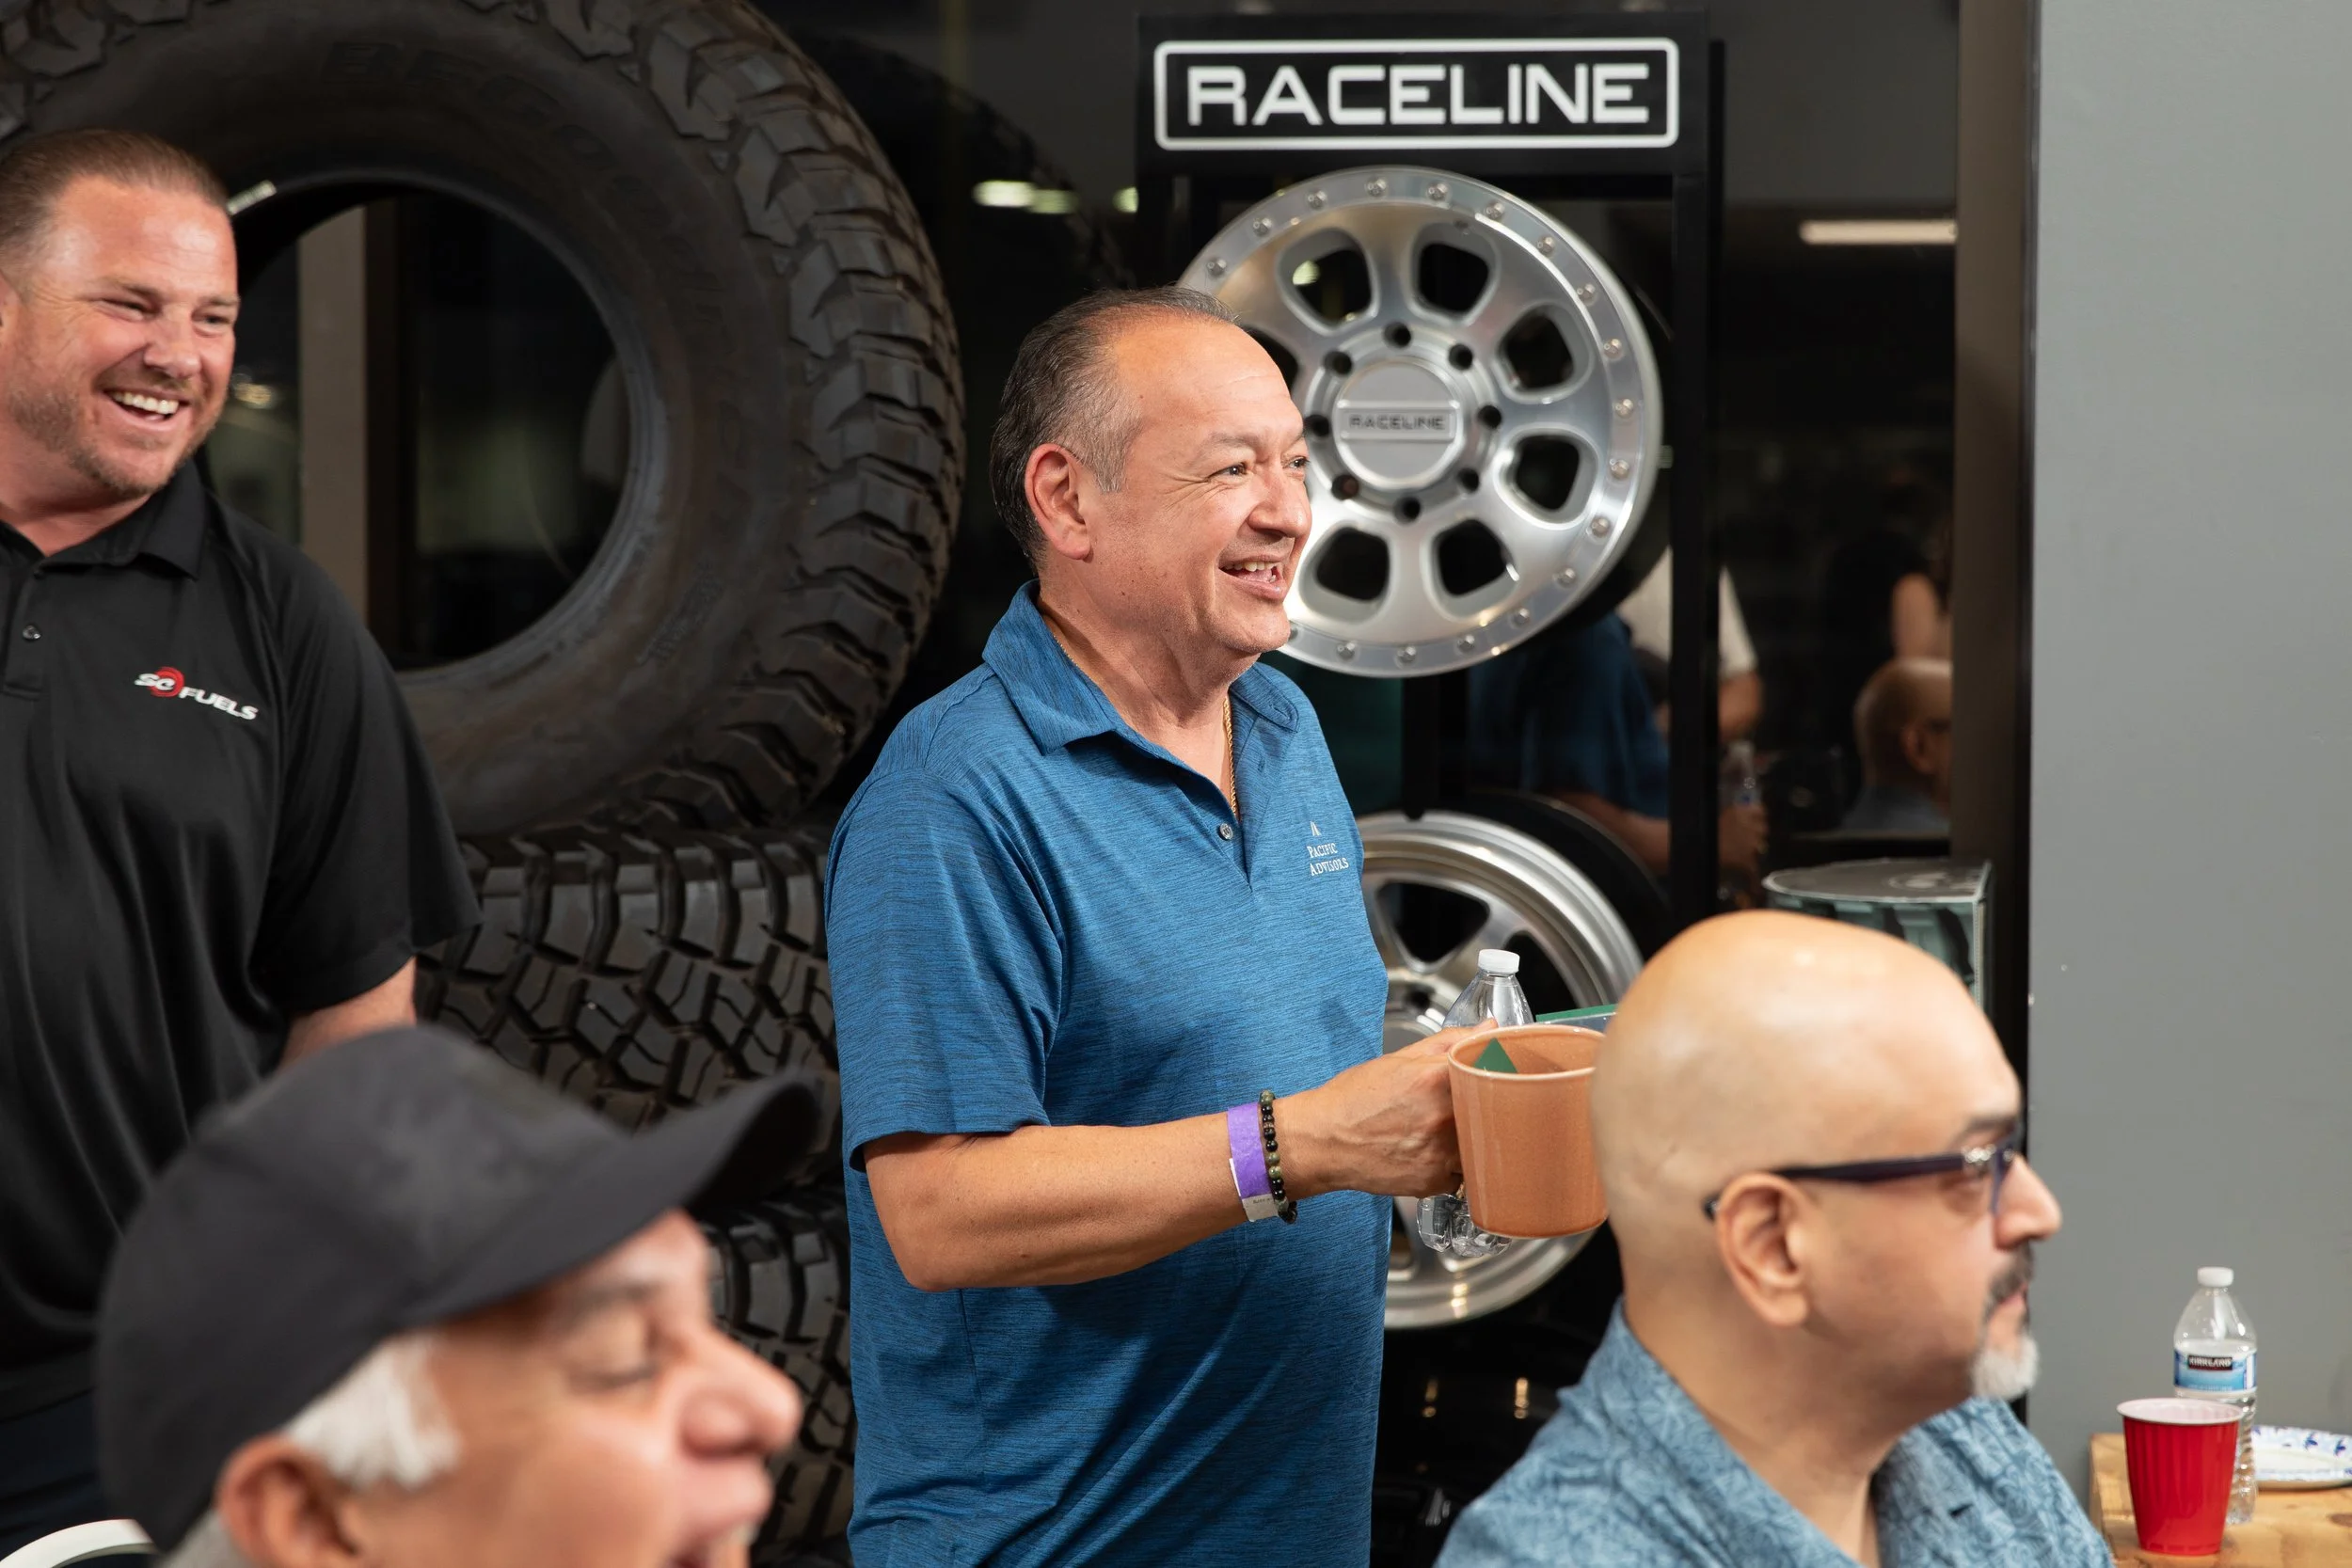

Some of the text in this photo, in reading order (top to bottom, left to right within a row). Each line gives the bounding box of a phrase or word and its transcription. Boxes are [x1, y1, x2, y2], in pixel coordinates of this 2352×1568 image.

[1187, 63, 1649, 126] RACELINE
[1348, 414, 1446, 431] RACELINE
[179, 687, 260, 721] FUELS
[1306, 842, 1339, 859] PACIFIC
[1309, 857, 1349, 877] ADVISORS
